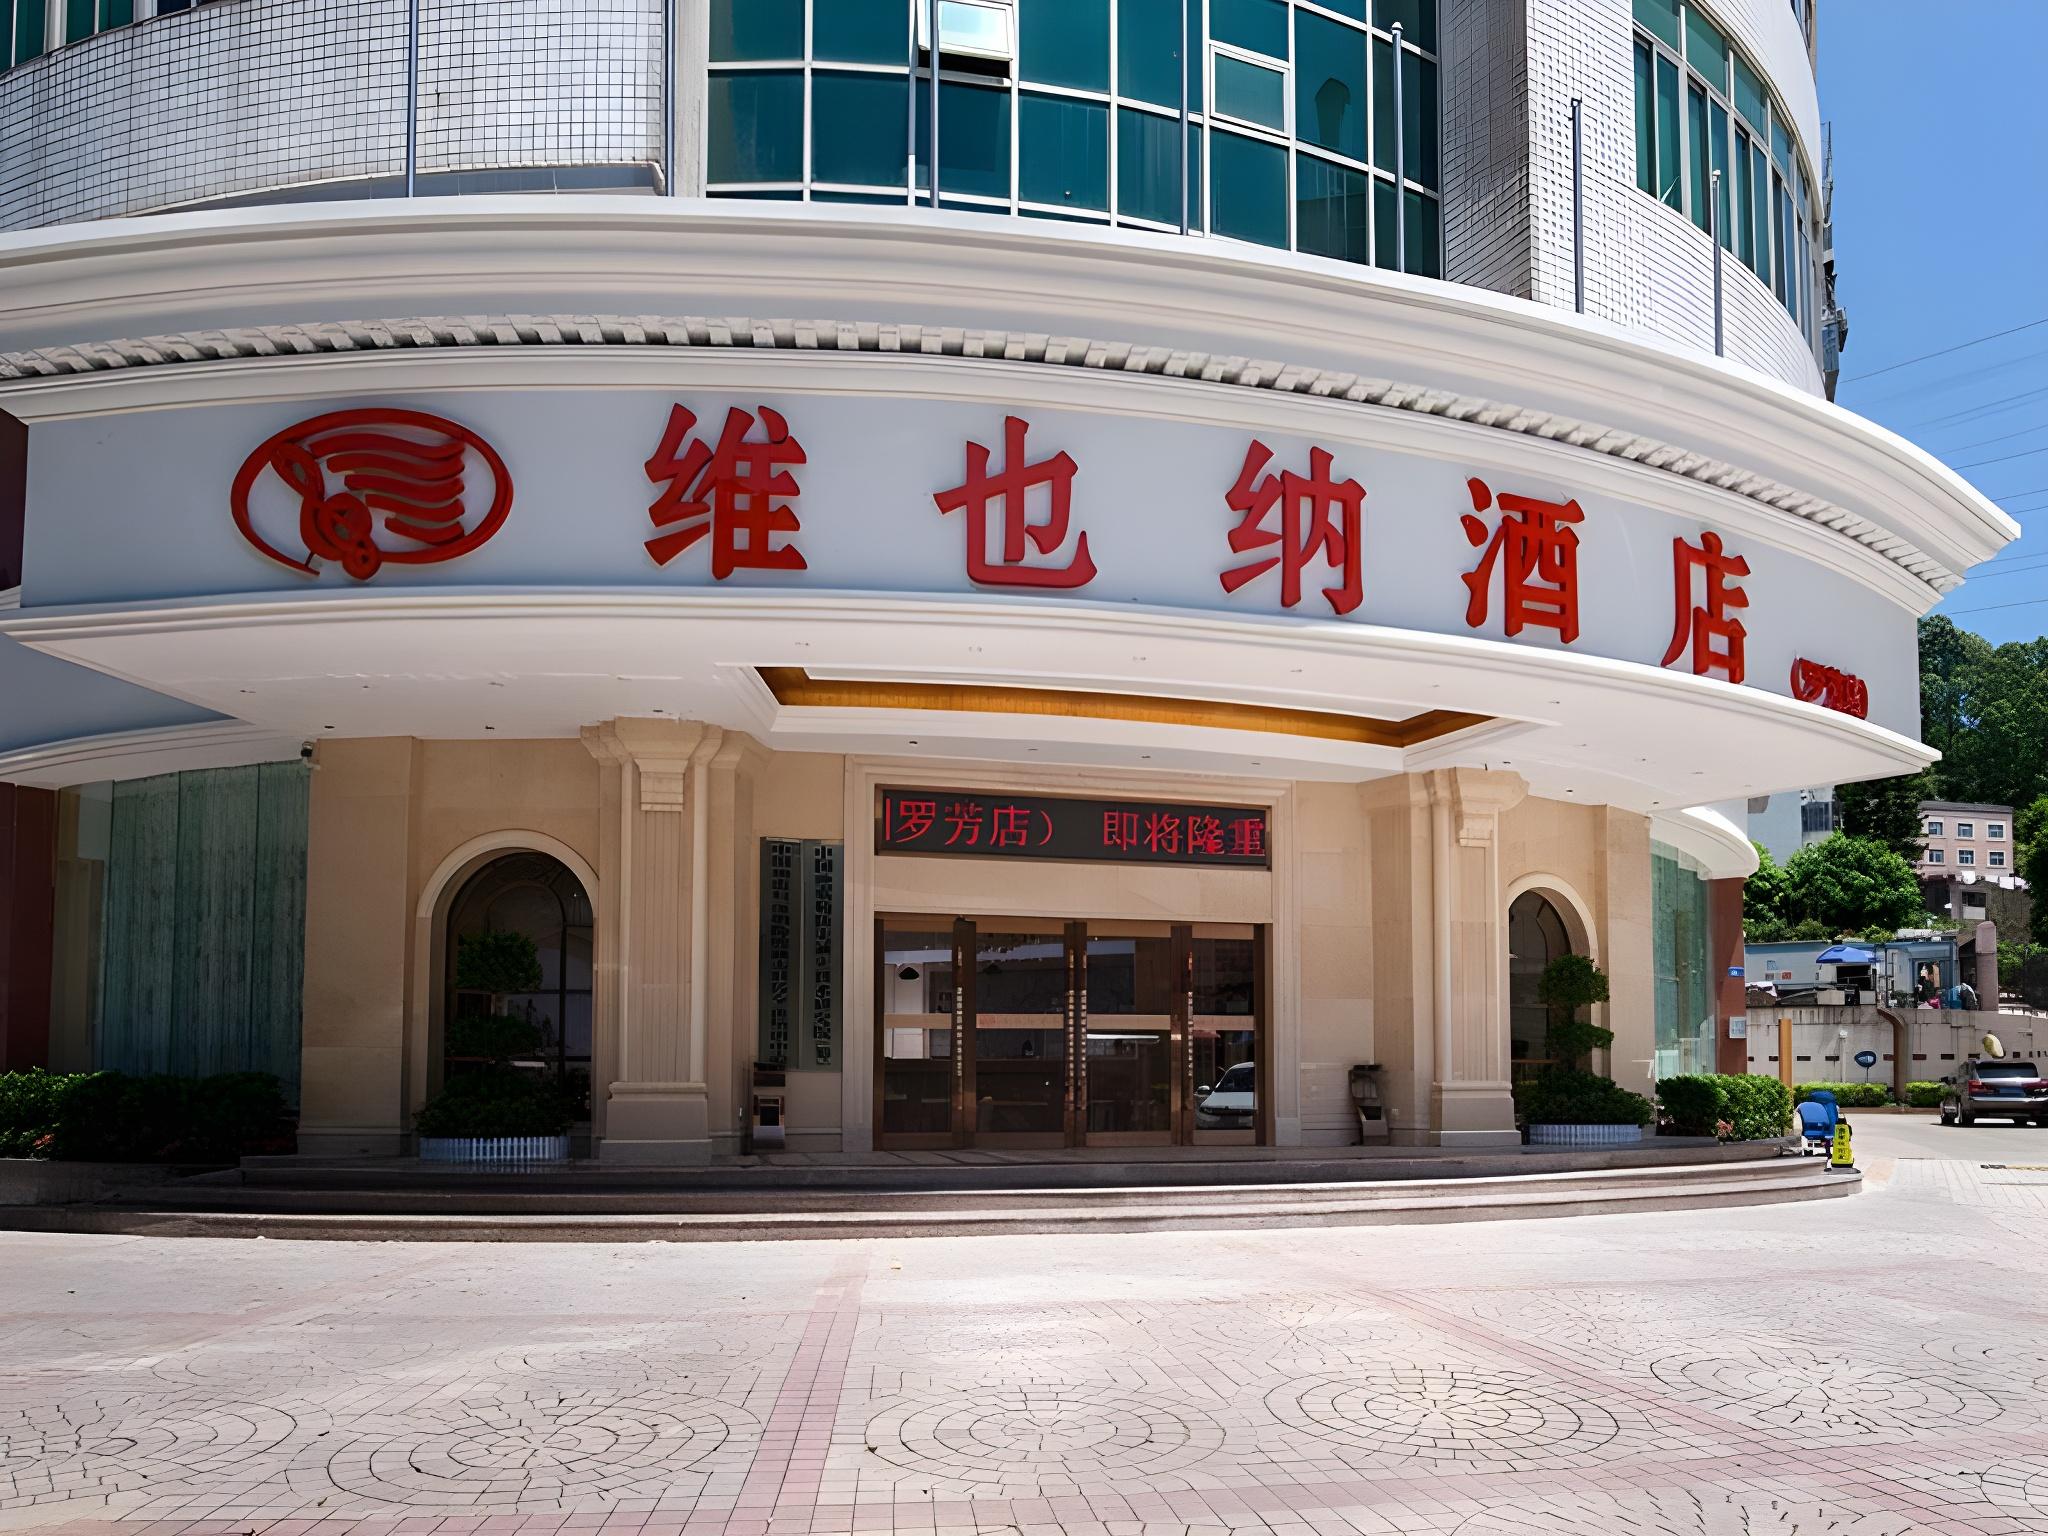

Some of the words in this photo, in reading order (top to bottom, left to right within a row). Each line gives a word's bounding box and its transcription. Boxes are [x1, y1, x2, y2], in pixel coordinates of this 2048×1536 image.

[645, 404, 1750, 684] 维也纳酒店
[1103, 810, 1266, 857] 即将隆重
